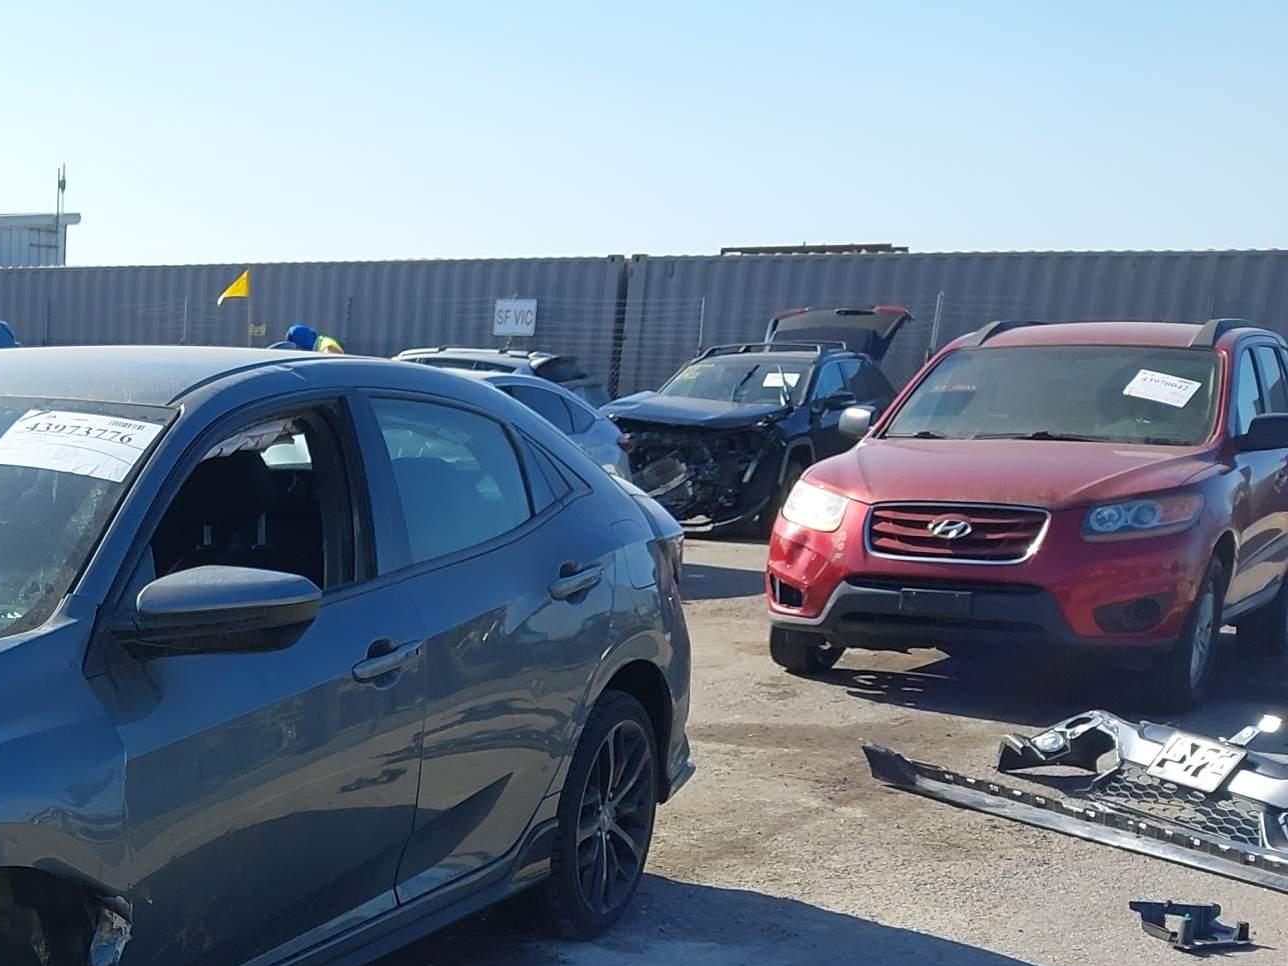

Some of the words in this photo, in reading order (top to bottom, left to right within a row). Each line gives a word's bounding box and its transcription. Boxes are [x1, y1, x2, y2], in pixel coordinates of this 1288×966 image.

[496, 309, 511, 325] SF
[514, 309, 533, 325] VIC
[25, 422, 136, 444] 43973776
